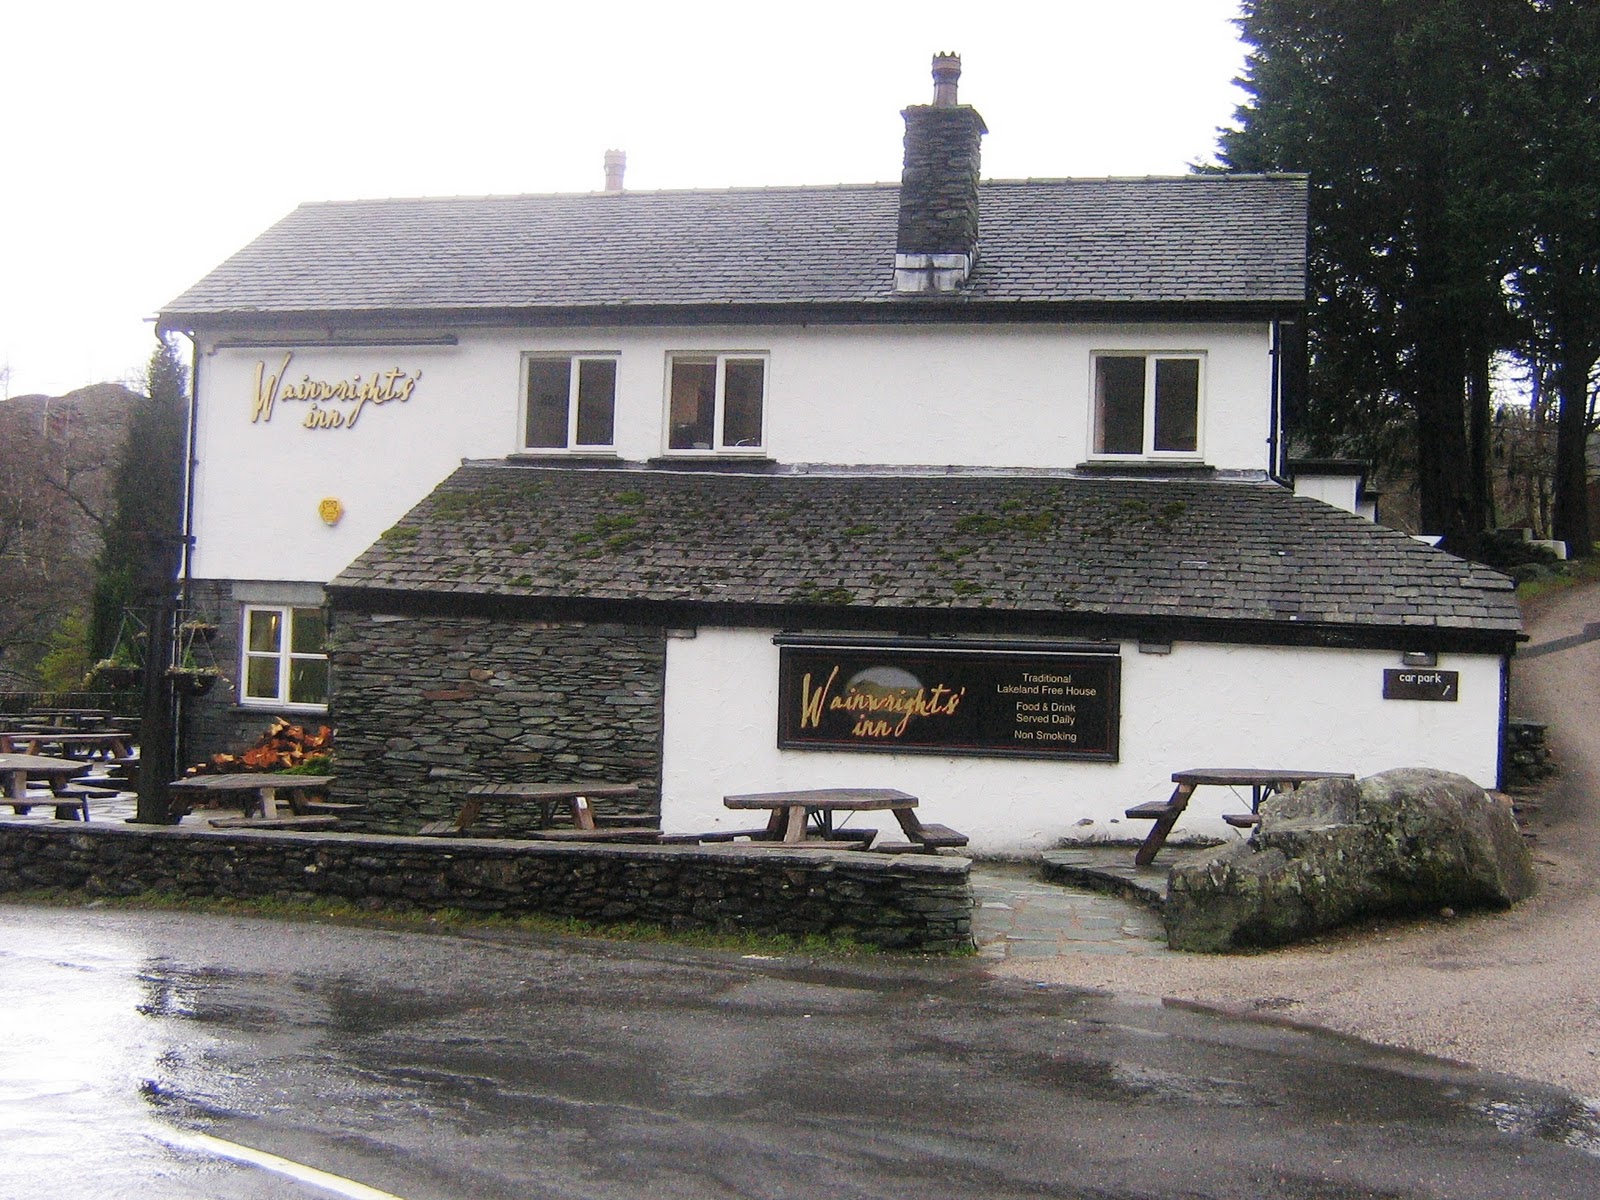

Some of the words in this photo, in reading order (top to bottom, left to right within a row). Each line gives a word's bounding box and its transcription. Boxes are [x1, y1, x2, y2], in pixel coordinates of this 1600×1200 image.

[303, 402, 345, 429] inn
[1022, 672, 1072, 683] Traditional
[1399, 674, 1416, 682] car
[1417, 673, 1442, 684] park
[997, 684, 1039, 694] Lakeland
[1041, 685, 1064, 695] Free
[1065, 686, 1097, 696] House
[1016, 701, 1040, 711] Food
[1042, 702, 1049, 712] &
[1051, 702, 1076, 712] Drink
[1016, 713, 1049, 723] Served
[1051, 714, 1076, 726] Daily
[852, 714, 893, 738] inn
[1014, 730, 1034, 739] Non
[1036, 731, 1077, 743] Smoking
